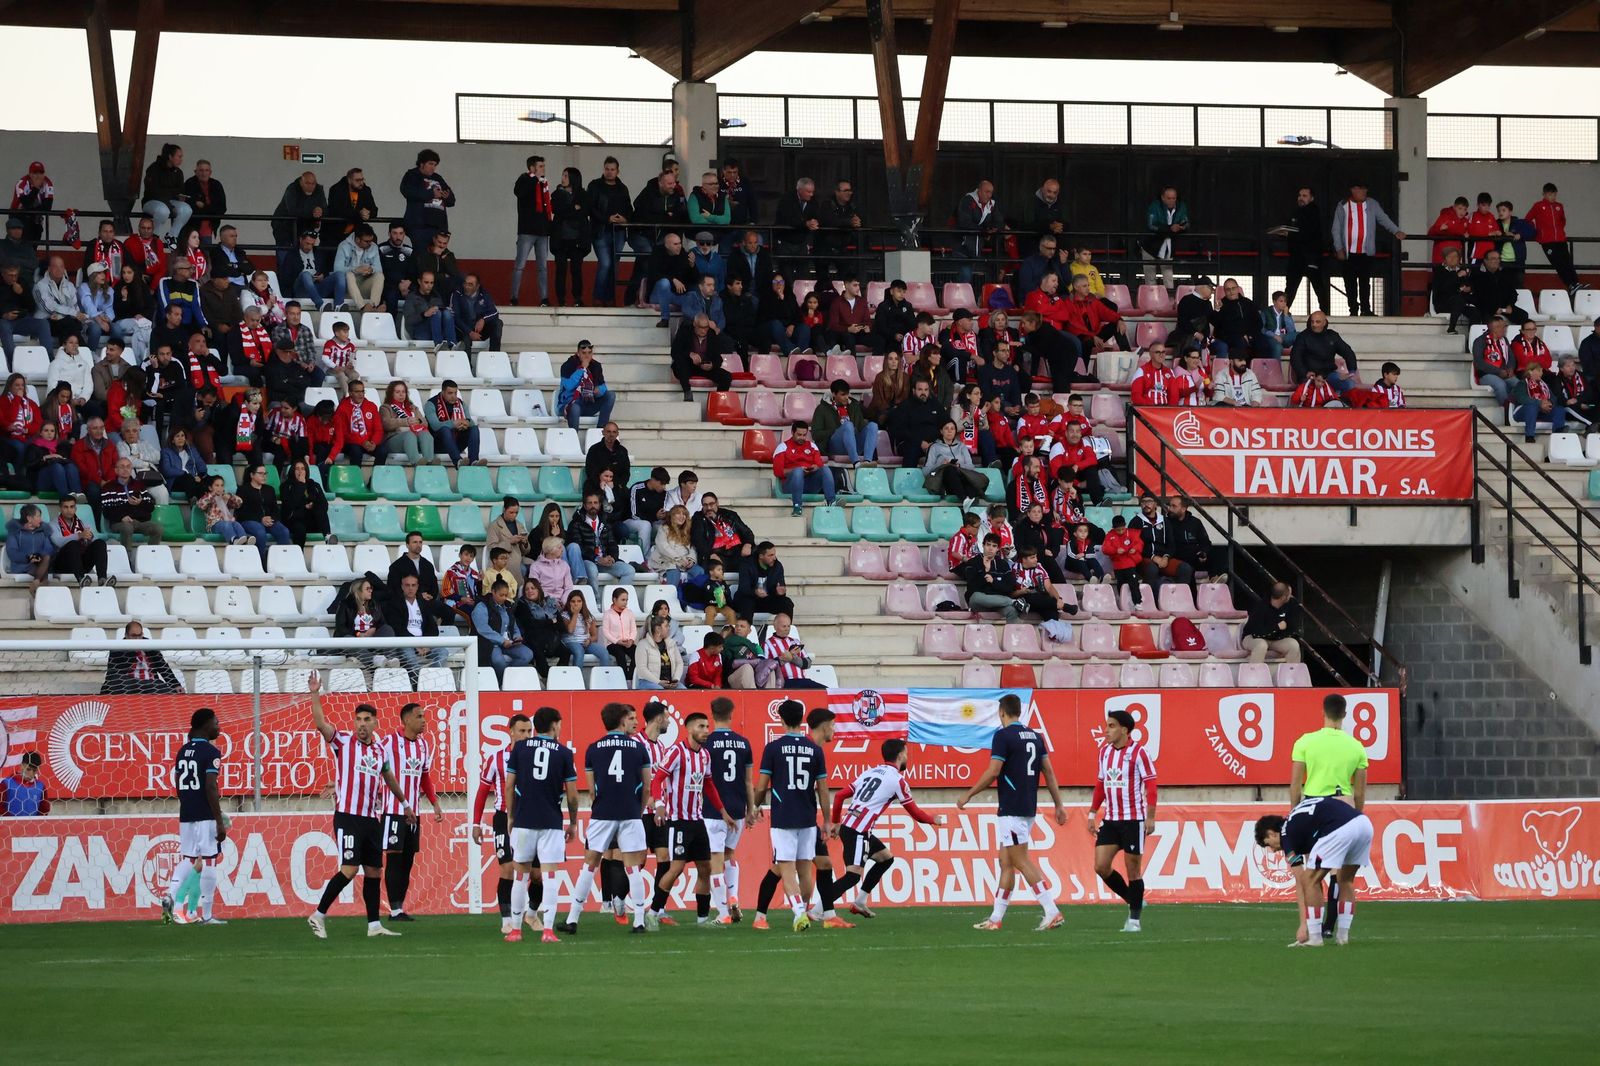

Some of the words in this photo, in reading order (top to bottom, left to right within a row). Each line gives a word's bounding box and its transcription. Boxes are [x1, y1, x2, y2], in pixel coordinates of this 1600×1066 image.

[1400, 478, 1436, 496] S.A.
[1238, 702, 1263, 748] 8
[1352, 702, 1378, 749] 8
[713, 740, 724, 749] JON
[726, 740, 733, 748] DE
[781, 745, 796, 754] IKER
[1025, 741, 1037, 776] 2
[1204, 724, 1247, 779] ZAMORA
[178, 759, 200, 791] 23
[532, 746, 551, 781] 9
[608, 749, 625, 783] 4
[723, 749, 737, 782] 3
[786, 755, 811, 790] 15
[856, 776, 882, 802] 18
[343, 835, 355, 849] 10
[391, 821, 398, 834] 4
[677, 831, 683, 844] 8
[1382, 819, 1463, 888] CF
